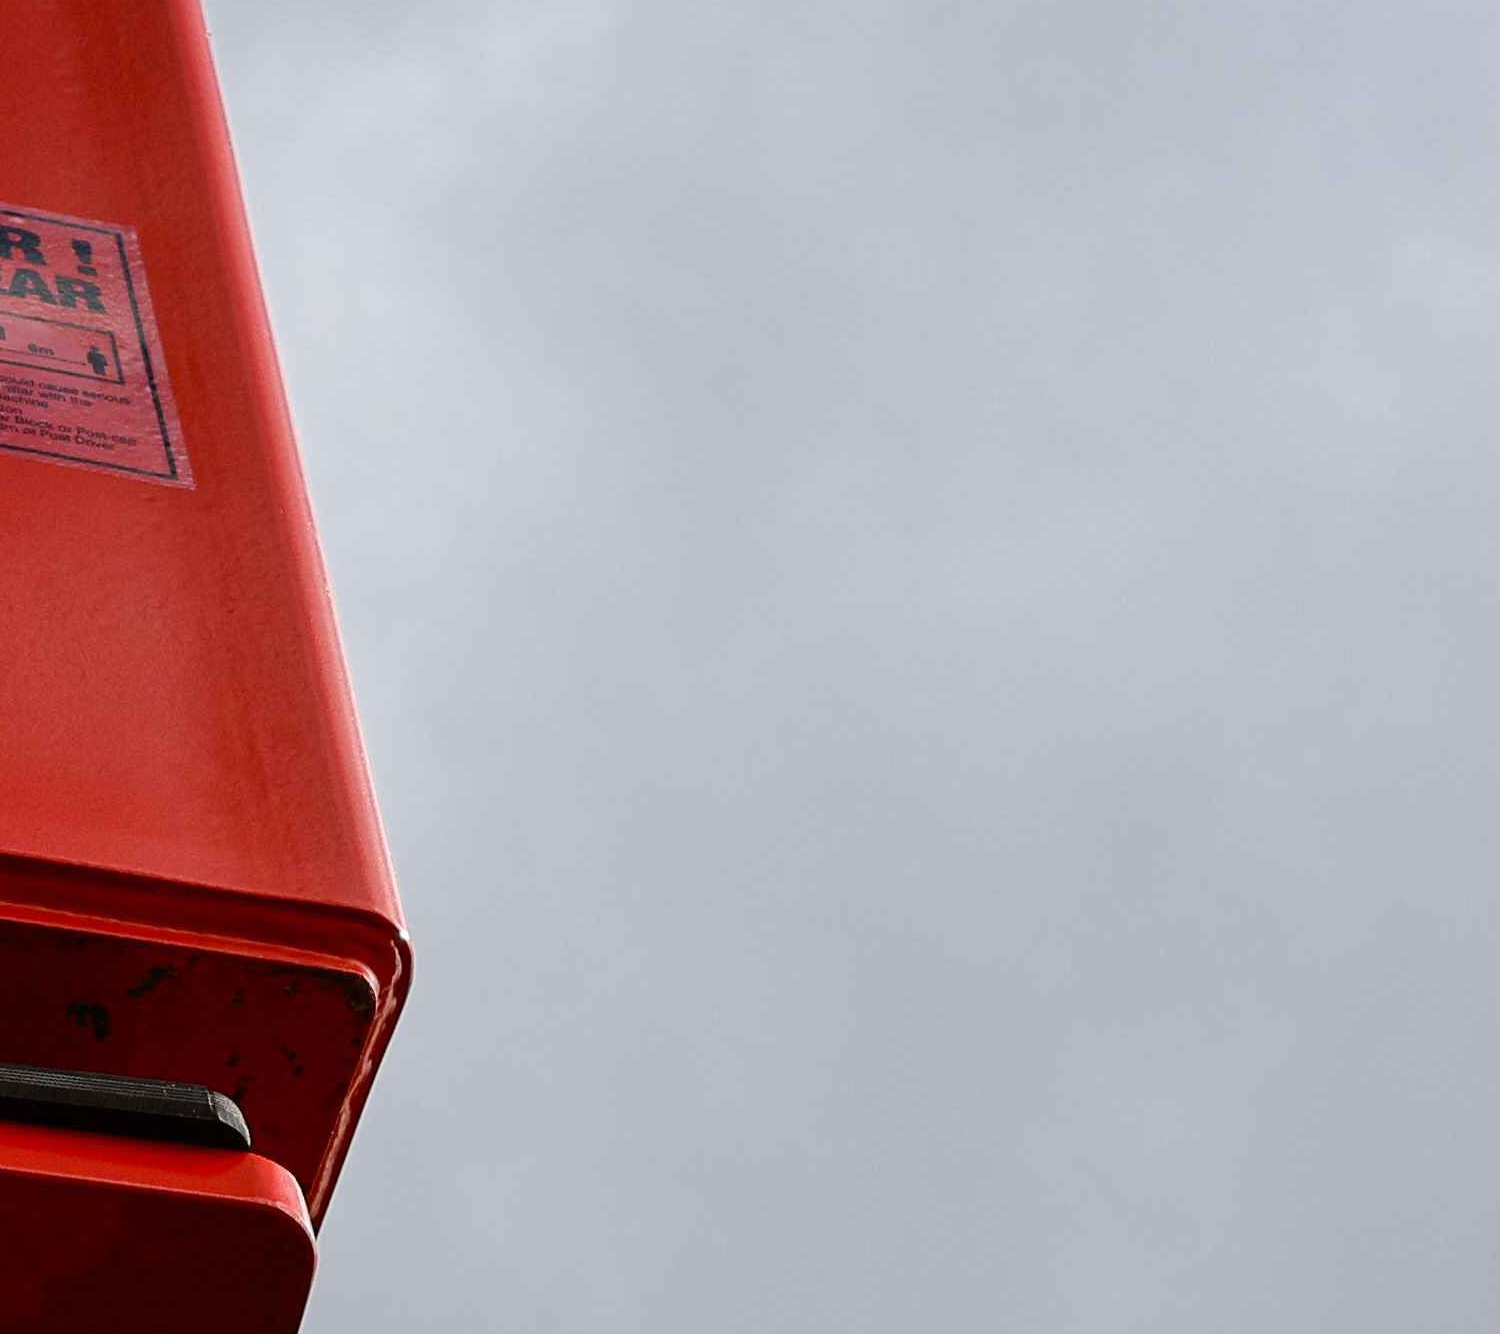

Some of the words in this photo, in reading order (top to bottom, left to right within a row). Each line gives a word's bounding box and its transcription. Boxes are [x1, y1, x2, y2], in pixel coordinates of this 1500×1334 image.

[27, 342, 55, 357] 6m
[14, 415, 54, 430] Block
[39, 429, 71, 442] Post
